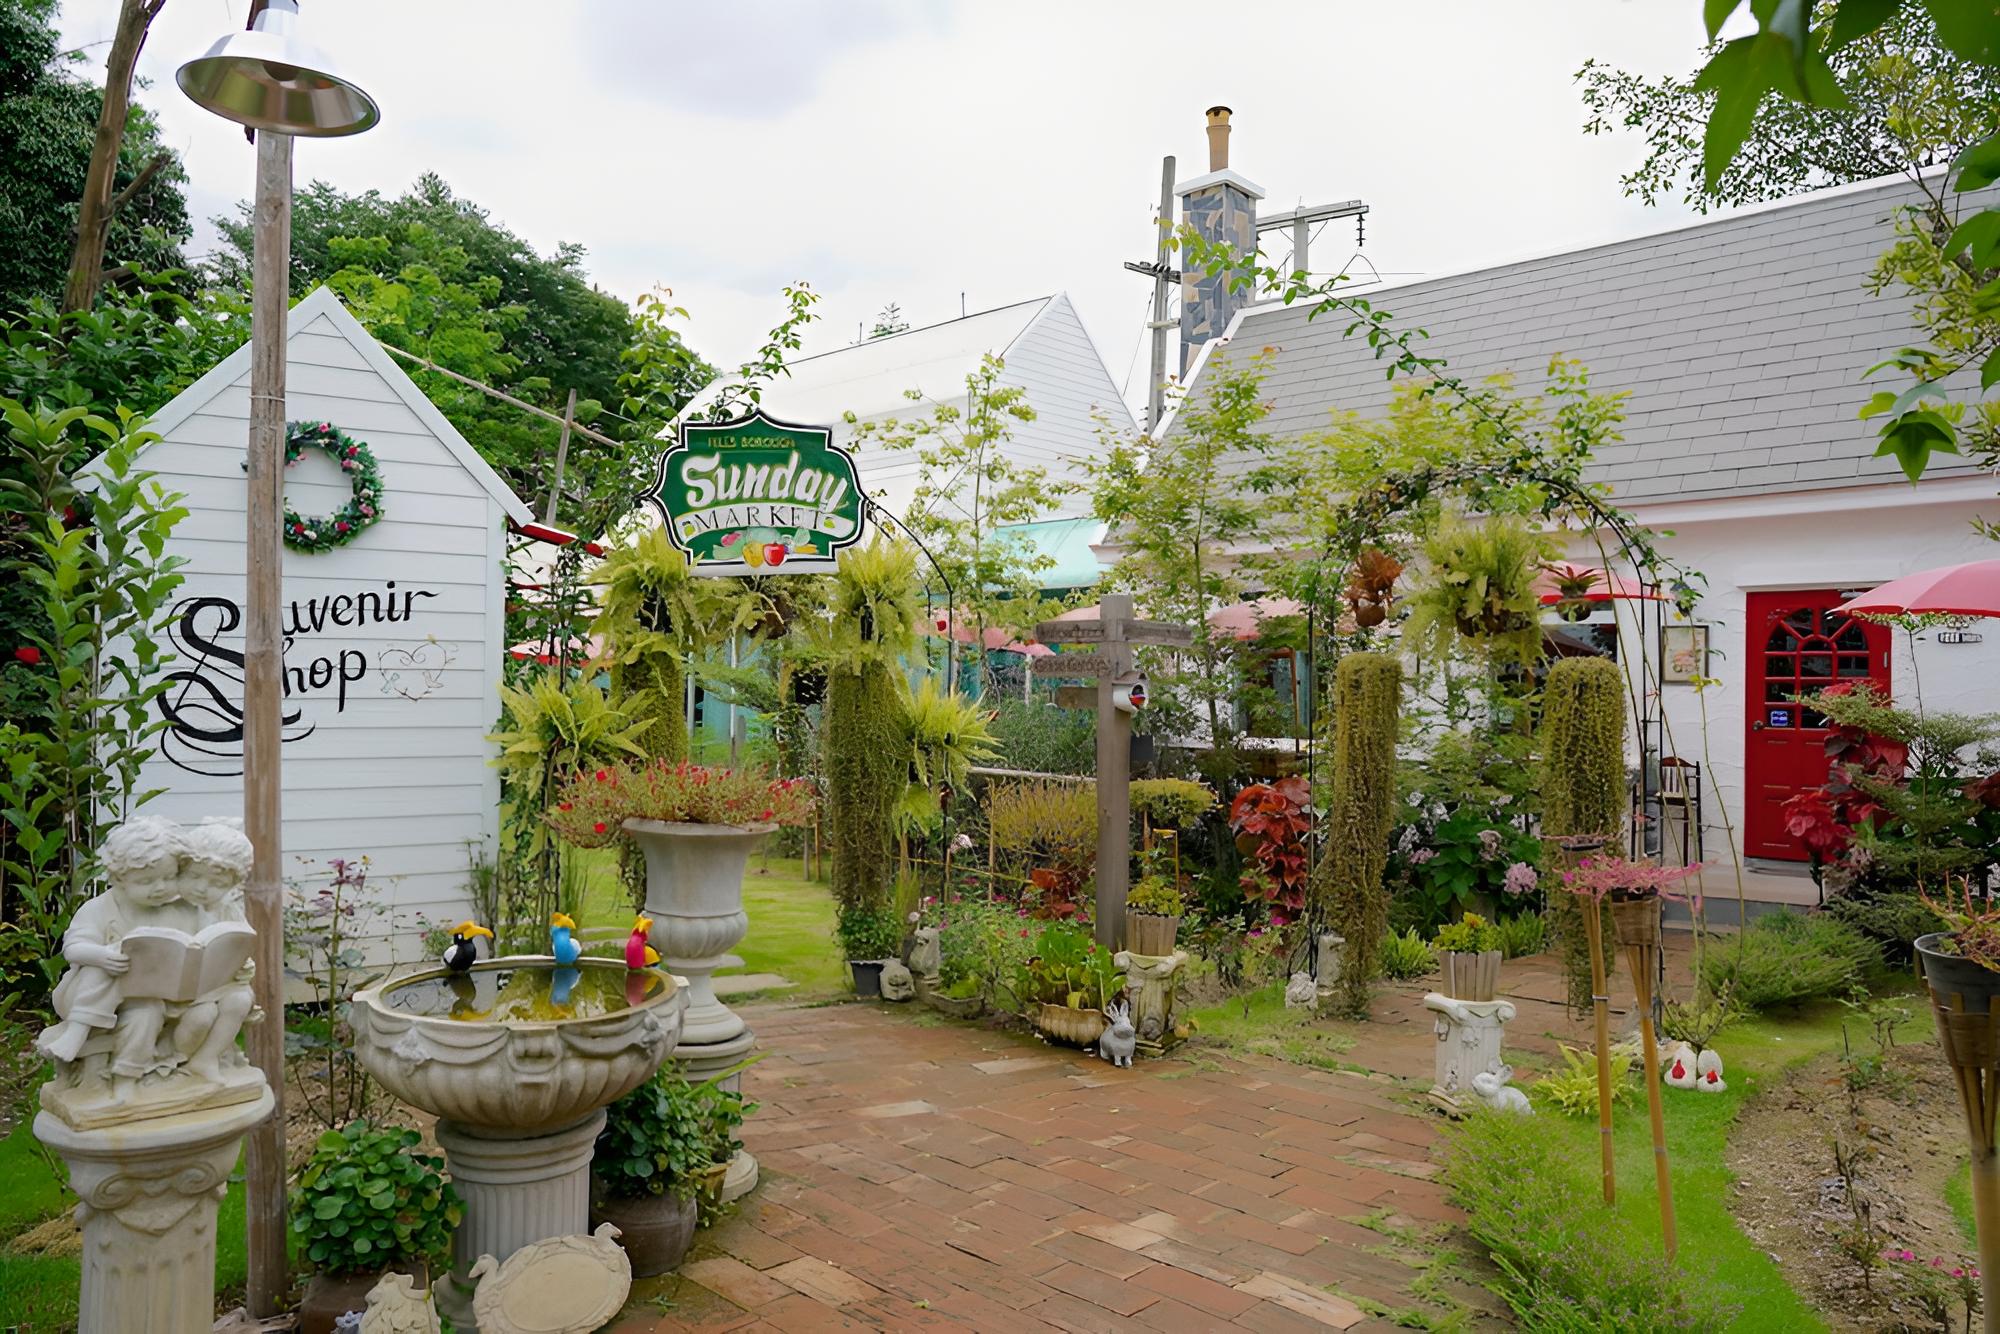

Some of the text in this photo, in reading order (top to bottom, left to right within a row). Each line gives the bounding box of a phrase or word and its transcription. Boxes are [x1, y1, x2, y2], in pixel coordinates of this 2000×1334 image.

[681, 450, 849, 512] Sunday
[693, 504, 822, 532] MARKET
[167, 580, 441, 668] Suvenir
